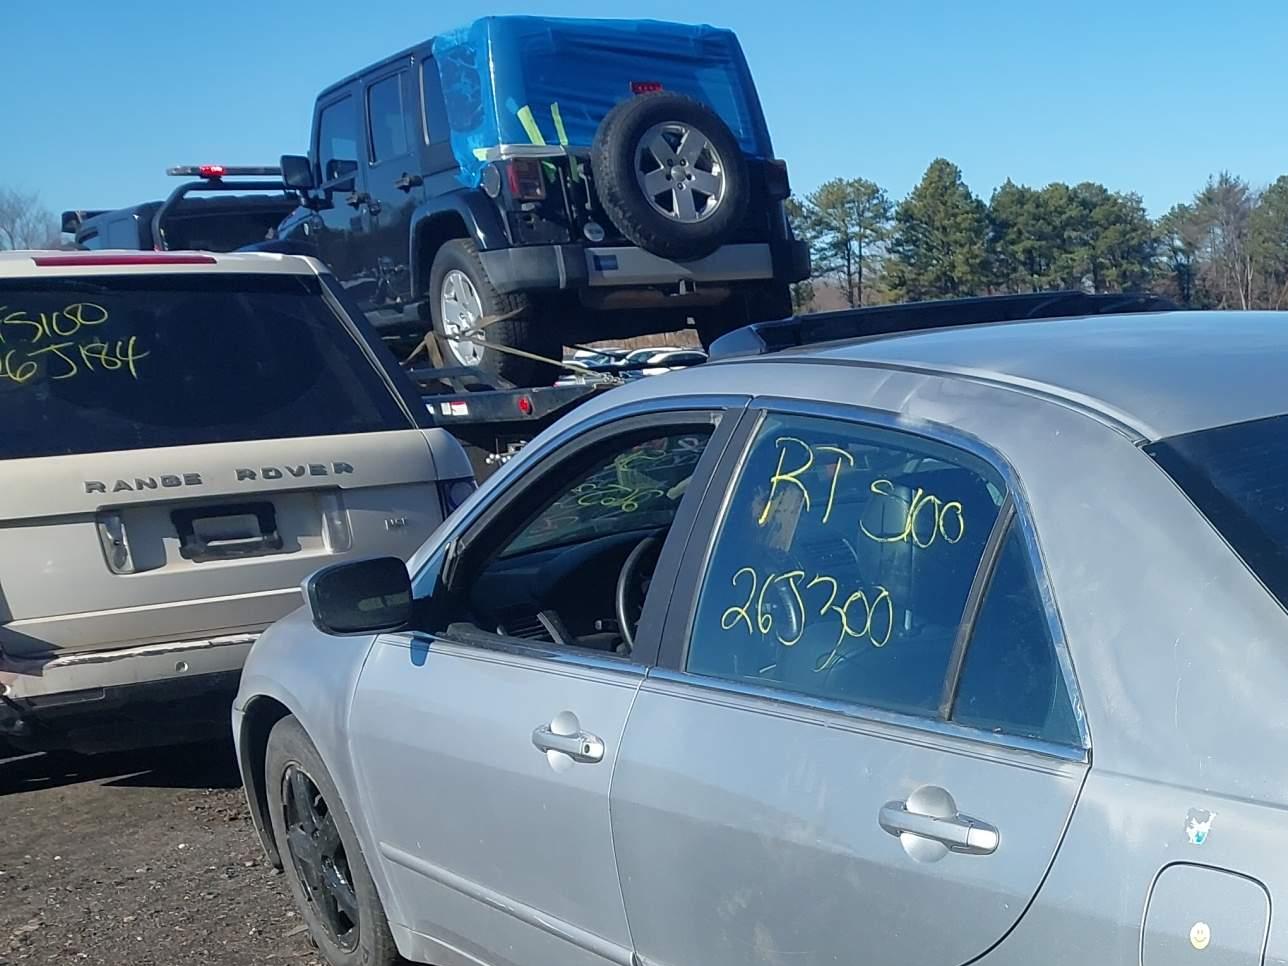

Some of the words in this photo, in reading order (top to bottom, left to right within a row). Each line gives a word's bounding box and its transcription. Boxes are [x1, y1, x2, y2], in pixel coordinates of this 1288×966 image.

[0, 335, 151, 383] 6J184
[84, 472, 204, 495] RANGE
[235, 461, 355, 483] ROVER
[757, 437, 855, 527] RT
[859, 479, 965, 549] S100
[720, 566, 895, 673] 26J300
